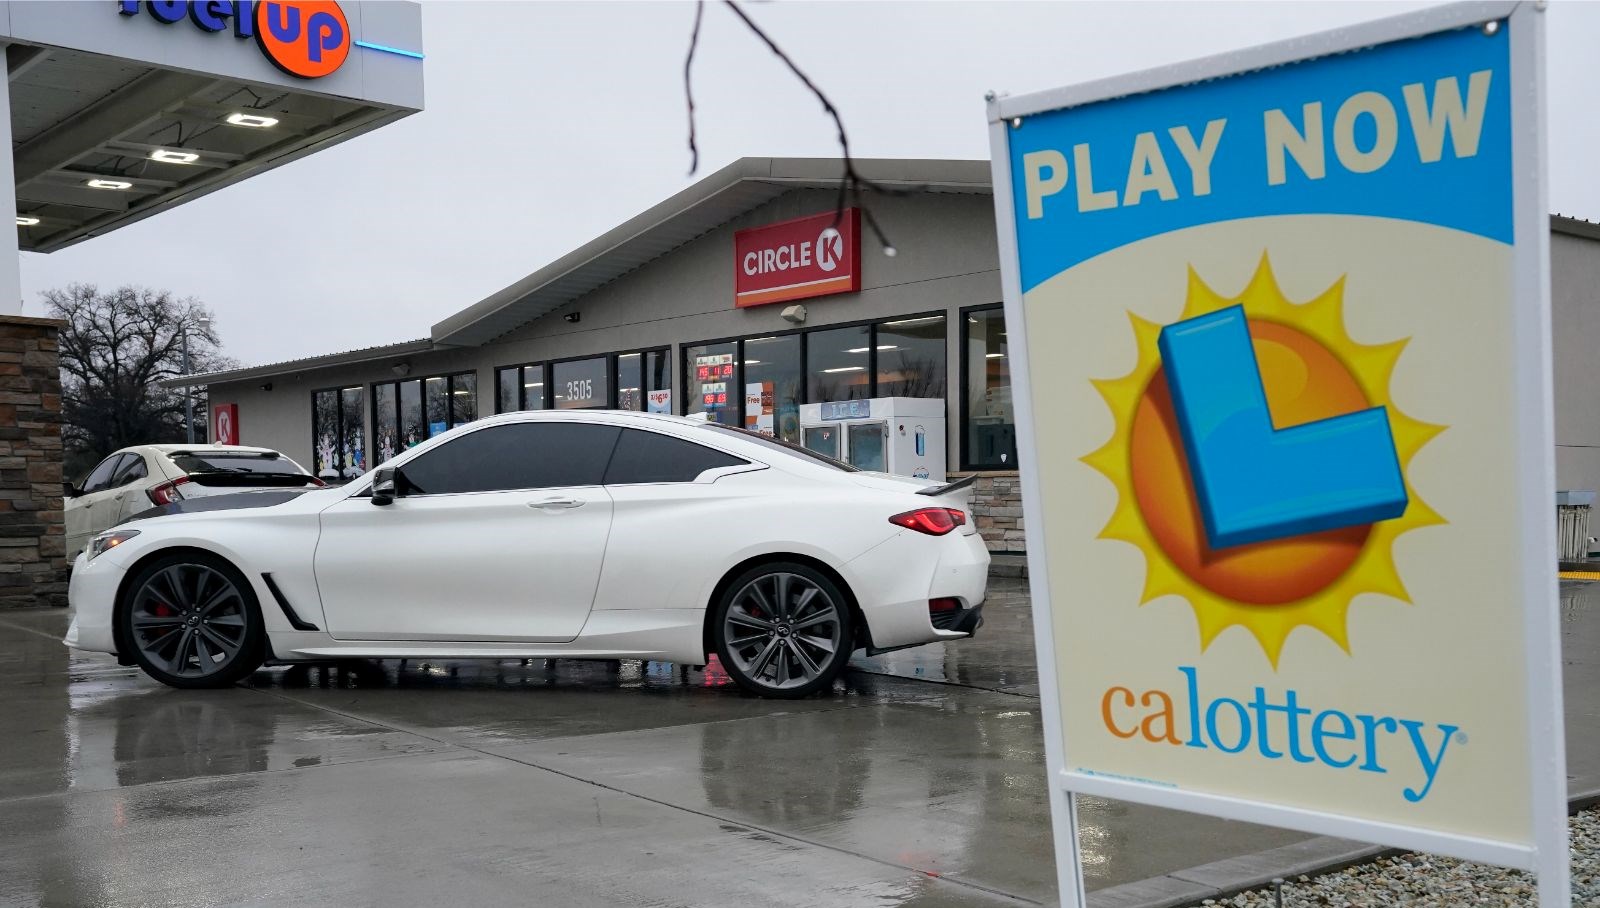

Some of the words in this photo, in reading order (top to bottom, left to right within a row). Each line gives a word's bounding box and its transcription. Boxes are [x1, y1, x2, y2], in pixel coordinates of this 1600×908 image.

[1023, 118, 1227, 220] PLAY
[1263, 69, 1493, 186] NOW
[743, 241, 812, 276] CIRCLE
[820, 232, 843, 268] K
[566, 379, 592, 401] 3505
[747, 396, 760, 404] Free
[832, 402, 859, 417] ICE
